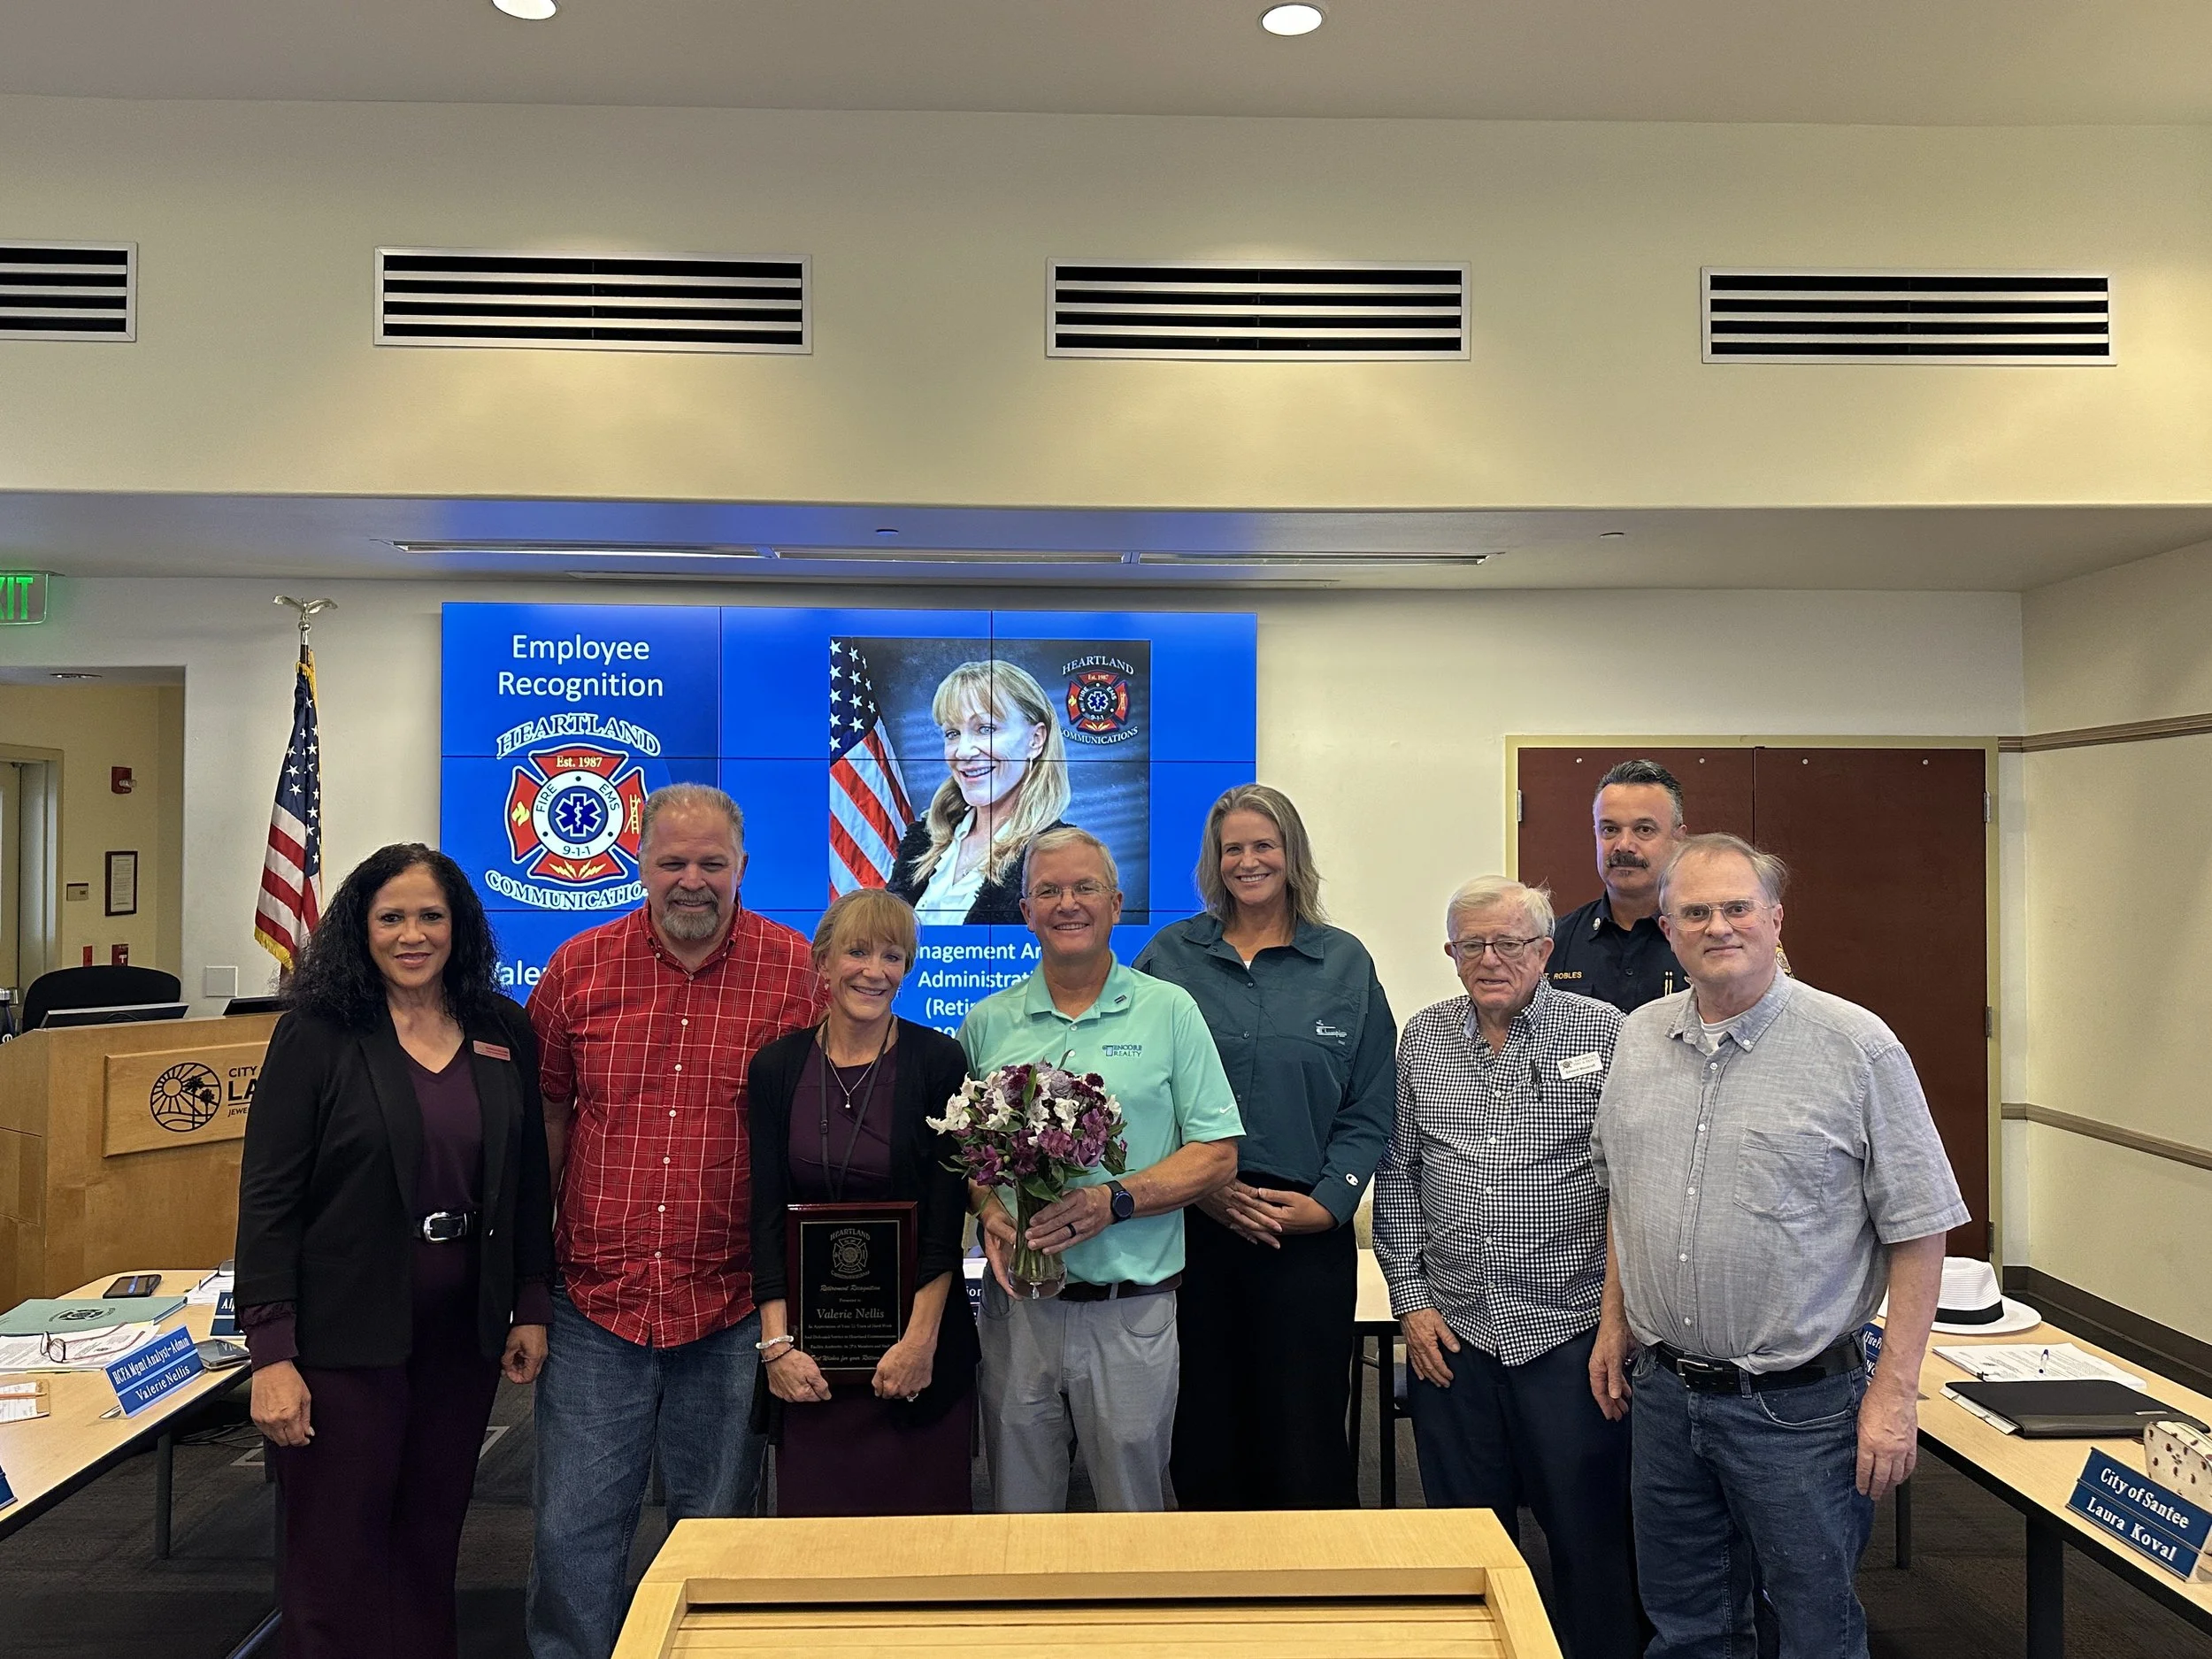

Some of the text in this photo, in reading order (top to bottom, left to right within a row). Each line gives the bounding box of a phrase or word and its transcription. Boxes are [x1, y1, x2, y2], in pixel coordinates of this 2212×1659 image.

[512, 634, 650, 665] Employee
[1062, 655, 1134, 675] HEARTLAND
[498, 672, 664, 702] Recognition
[1079, 687, 1089, 701] FIRE
[1106, 686, 1118, 701] EMS
[497, 712, 660, 758] HEARTLAND
[1061, 726, 1139, 744] OMMUNICATIONS
[556, 756, 603, 768] Est. 1987
[535, 783, 557, 812] FIRE
[599, 783, 619, 810] EMS
[563, 845, 591, 856] 9-1-1
[485, 870, 647, 910] COMMUNICATIO
[918, 943, 1016, 964] nagement
[918, 970, 1033, 988] Administrat
[1553, 972, 1582, 980] ROBLES
[228, 1066, 258, 1078] CITY
[227, 1107, 248, 1118] JEWE
[817, 1308, 885, 1319] Valerie Nellis
[127, 1358, 149, 1377] Mgmt
[135, 1365, 190, 1401] Valerie Nellis
[2100, 1467, 2190, 1529] City of Santee
[2085, 1496, 2177, 1562] Laura Koval
